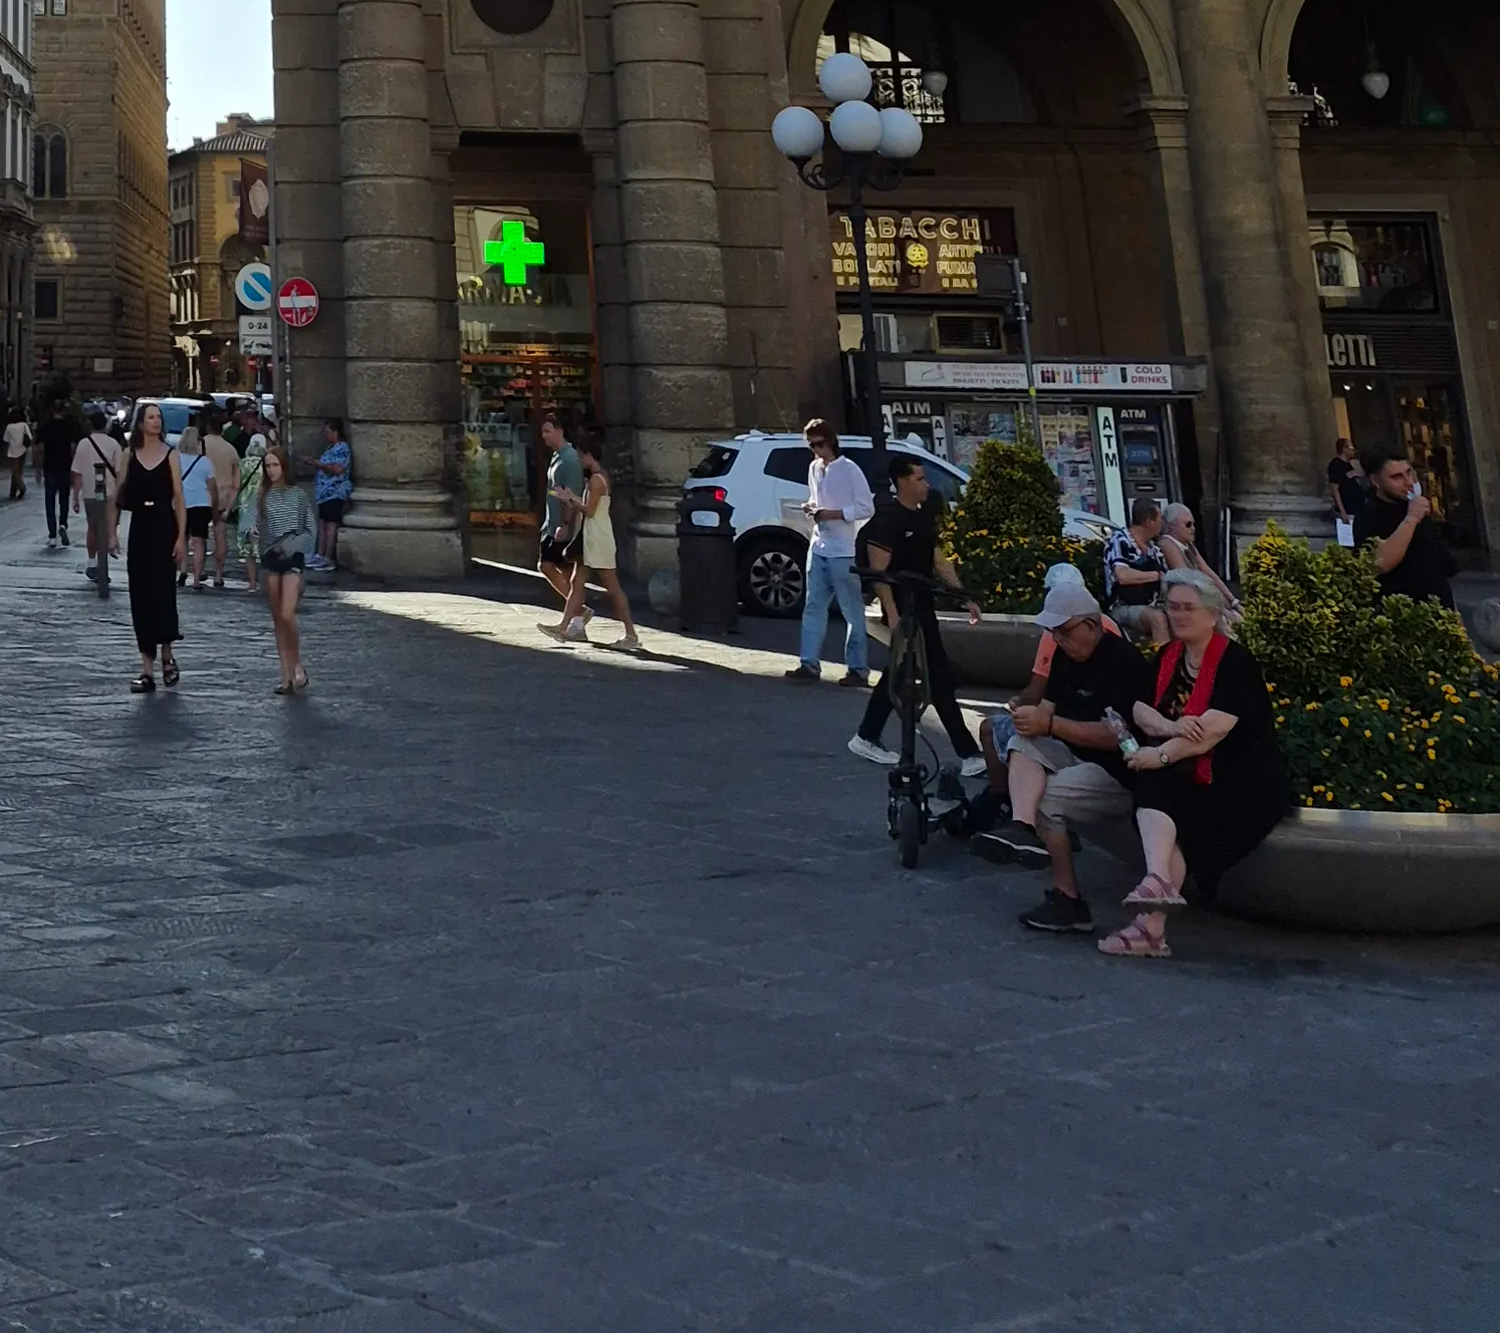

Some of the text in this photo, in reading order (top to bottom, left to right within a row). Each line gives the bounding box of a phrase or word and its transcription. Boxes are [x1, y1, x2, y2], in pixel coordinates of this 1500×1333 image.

[838, 215, 991, 241] TABACCHI
[832, 242, 896, 257] VAORI
[1135, 366, 1162, 374] COLD
[1131, 375, 1168, 384] DRINKS
[892, 402, 931, 414] ATM
[1120, 409, 1147, 419] ATM
[1102, 416, 1118, 467] ATM
